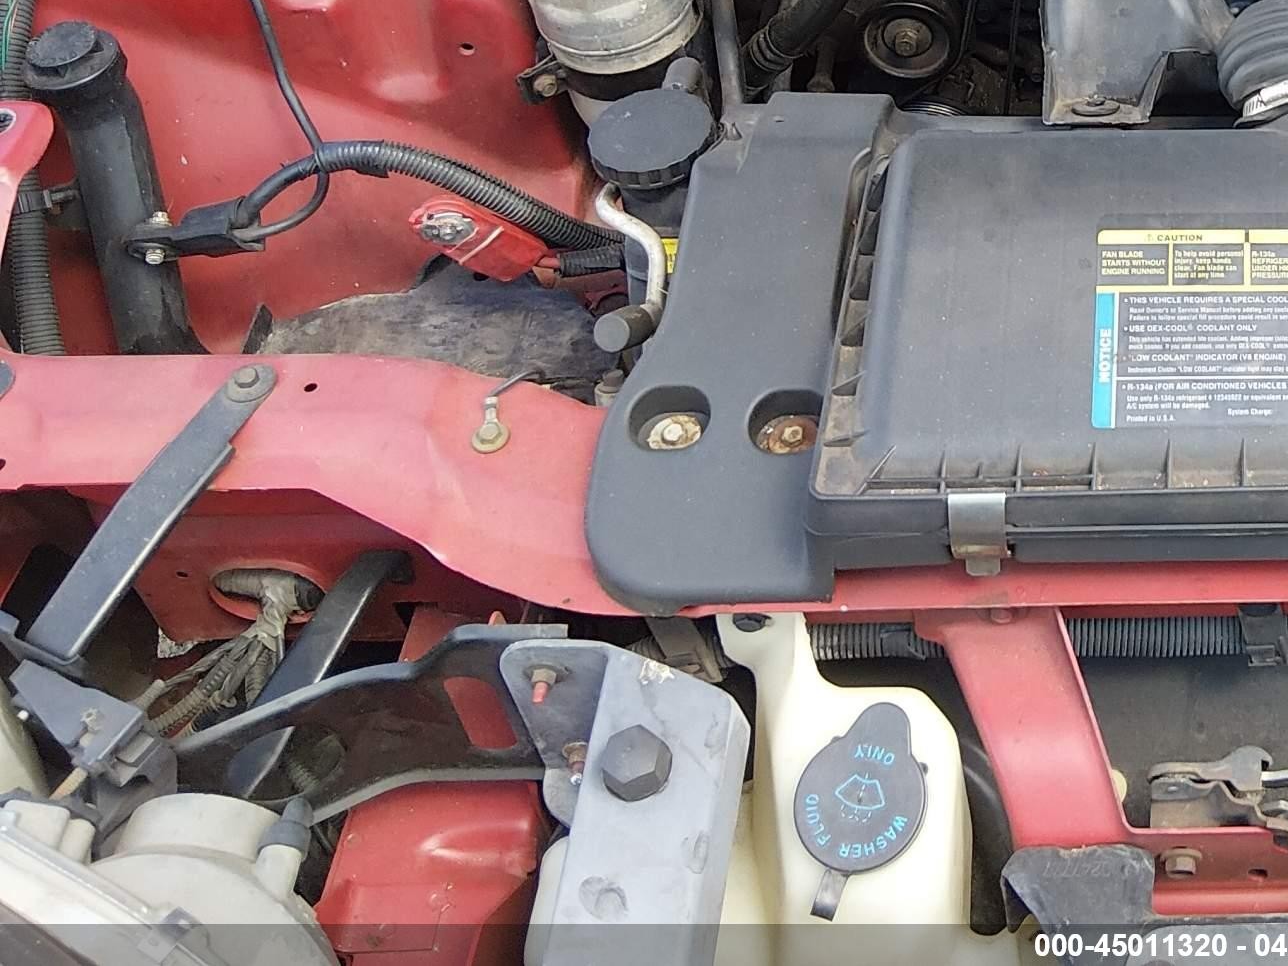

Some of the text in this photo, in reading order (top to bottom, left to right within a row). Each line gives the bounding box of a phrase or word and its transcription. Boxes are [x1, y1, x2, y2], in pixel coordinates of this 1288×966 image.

[1130, 296, 1147, 304] THIS
[1149, 296, 1182, 304] VEHICLE
[1099, 329, 1111, 382] NOTICE
[1155, 383, 1175, 391] (FOR
[1176, 383, 1190, 391] AIR
[1191, 383, 1246, 391] CONDITIONED
[1248, 382, 1287, 390] VEHICLES
[854, 743, 895, 765] ONLY
[805, 793, 908, 858] WASHER FLUID
